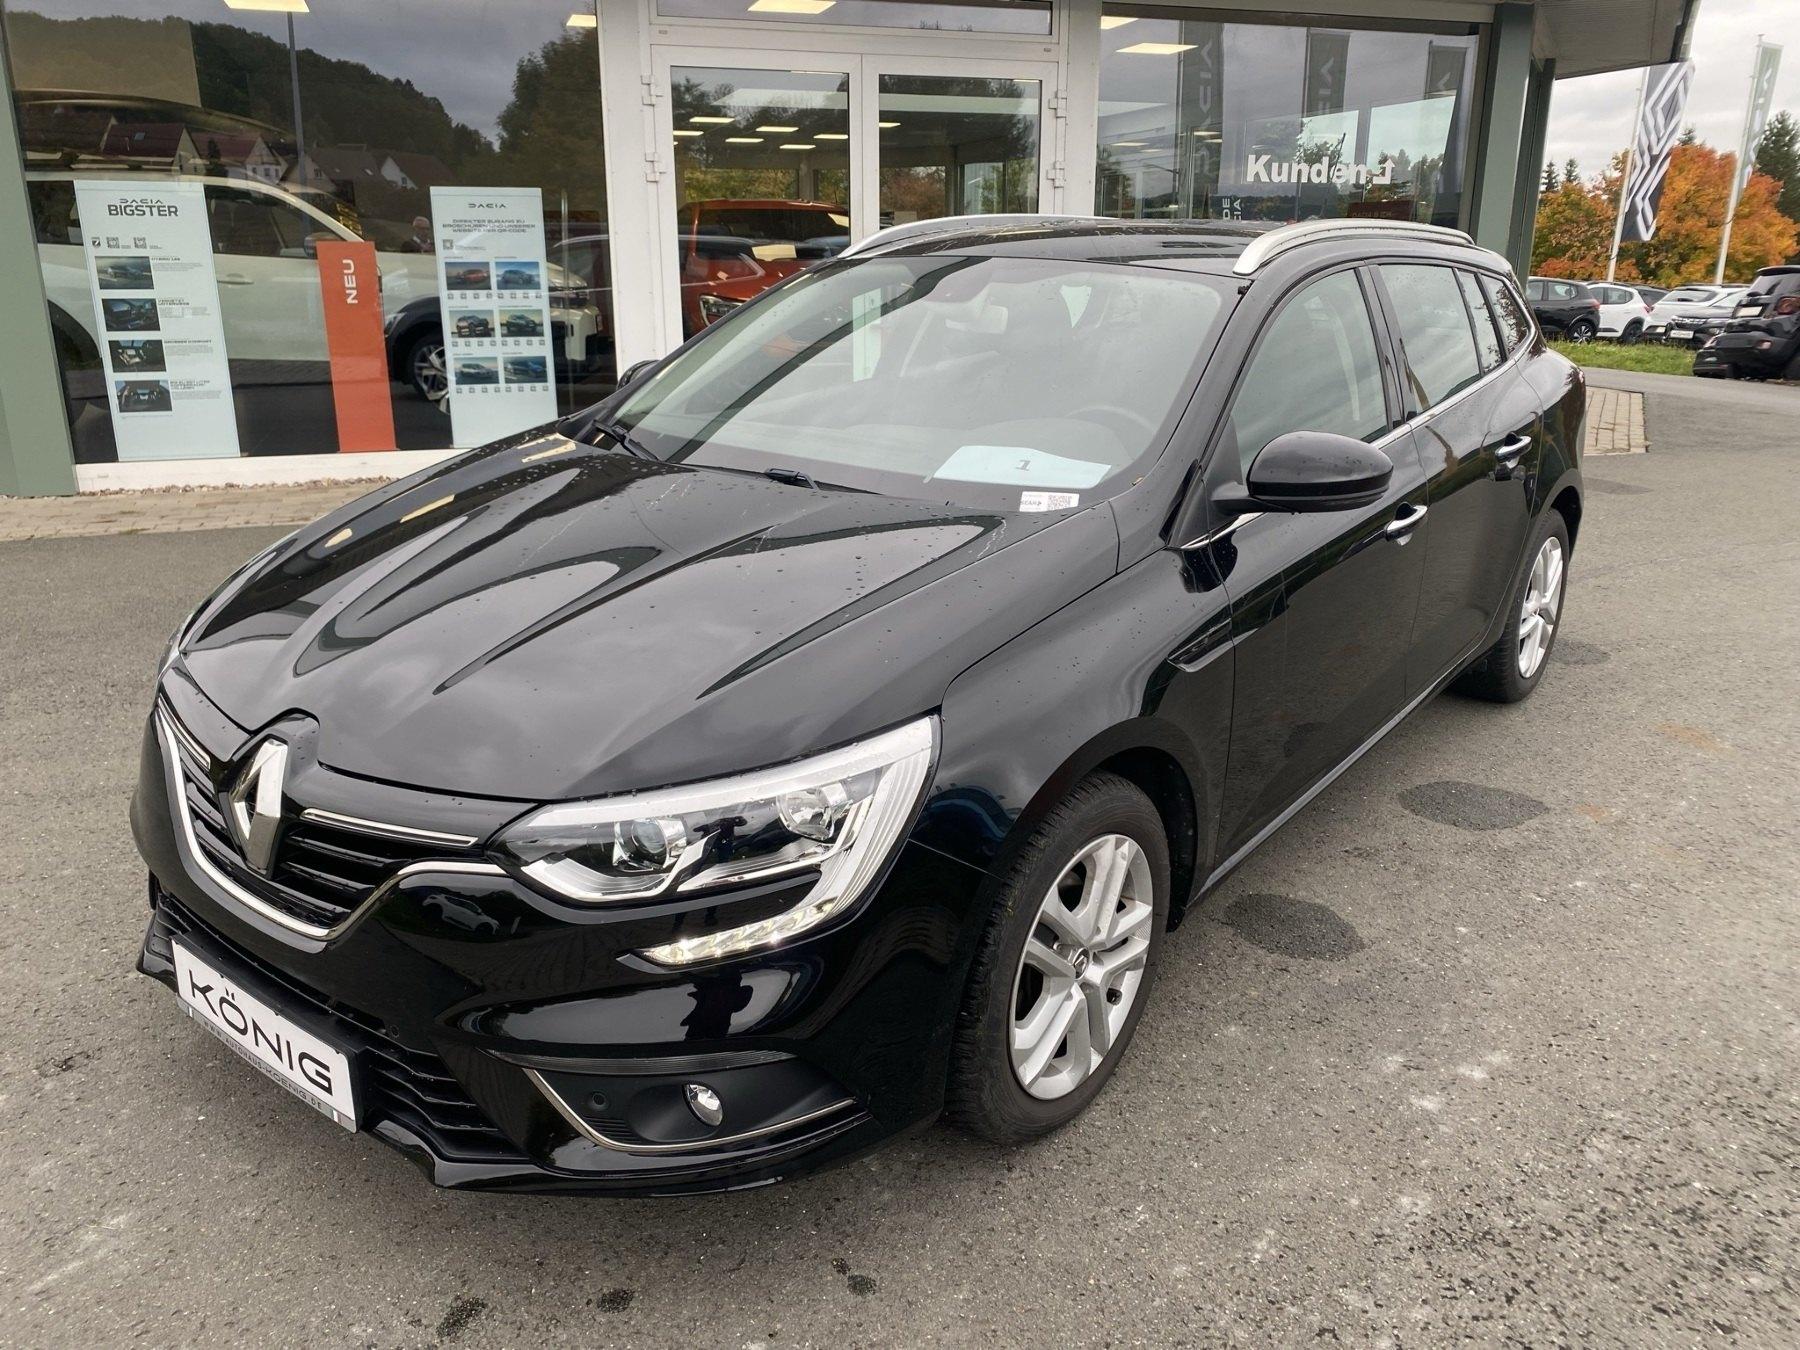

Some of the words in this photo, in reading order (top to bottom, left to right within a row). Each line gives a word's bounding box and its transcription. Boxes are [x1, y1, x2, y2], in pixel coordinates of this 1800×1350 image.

[1246, 154, 1367, 184] Kunden
[107, 204, 179, 217] BIGSTER
[342, 259, 359, 304] NEU
[188, 968, 334, 1097] KÖNIG
